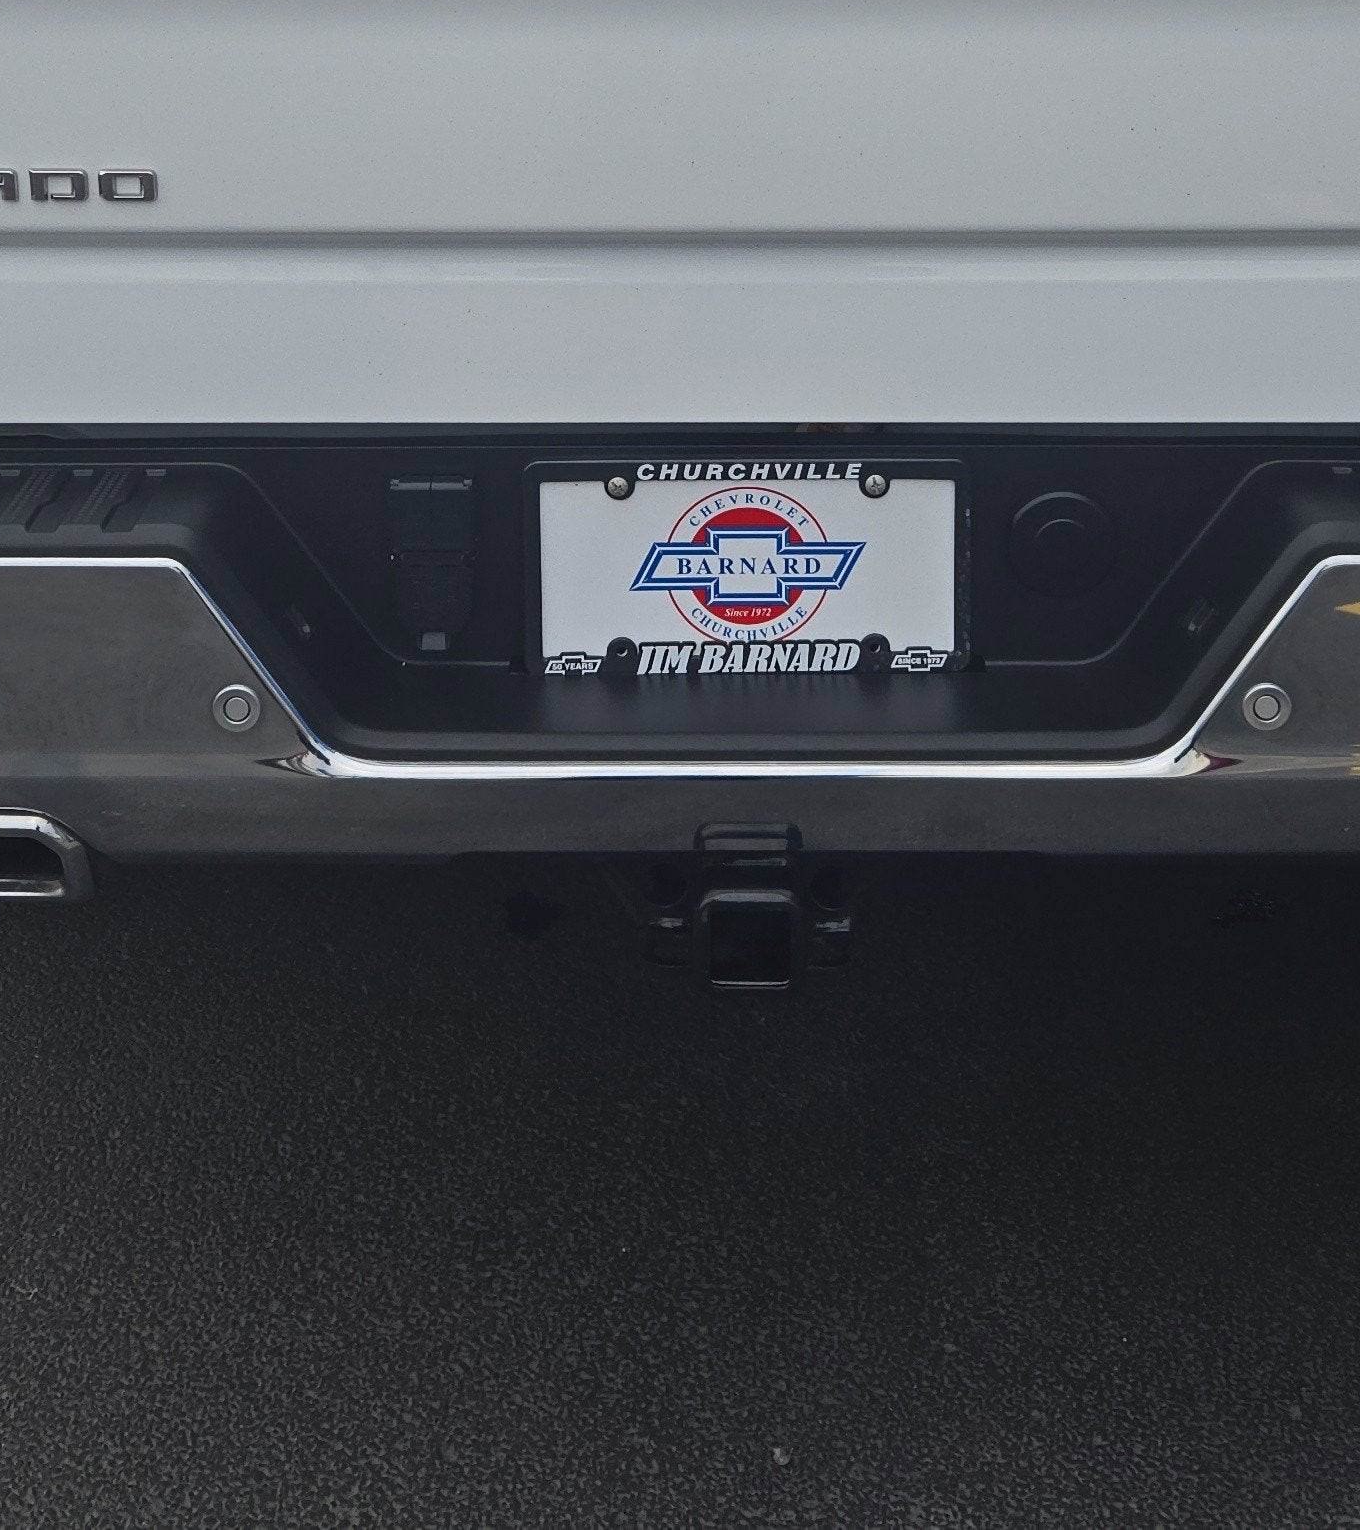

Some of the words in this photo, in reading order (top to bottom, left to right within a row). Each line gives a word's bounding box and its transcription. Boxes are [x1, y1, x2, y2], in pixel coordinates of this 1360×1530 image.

[635, 462, 863, 482] CHURCHVILLE
[689, 493, 810, 528] CHEVROLET
[676, 557, 822, 575] BARNARD
[724, 608, 749, 618] Since
[750, 608, 772, 618] 1972
[691, 606, 808, 641] CHURCHVILLE
[565, 662, 594, 671] YEARS
[636, 644, 694, 676] JIM
[697, 642, 862, 675] BARNARD
